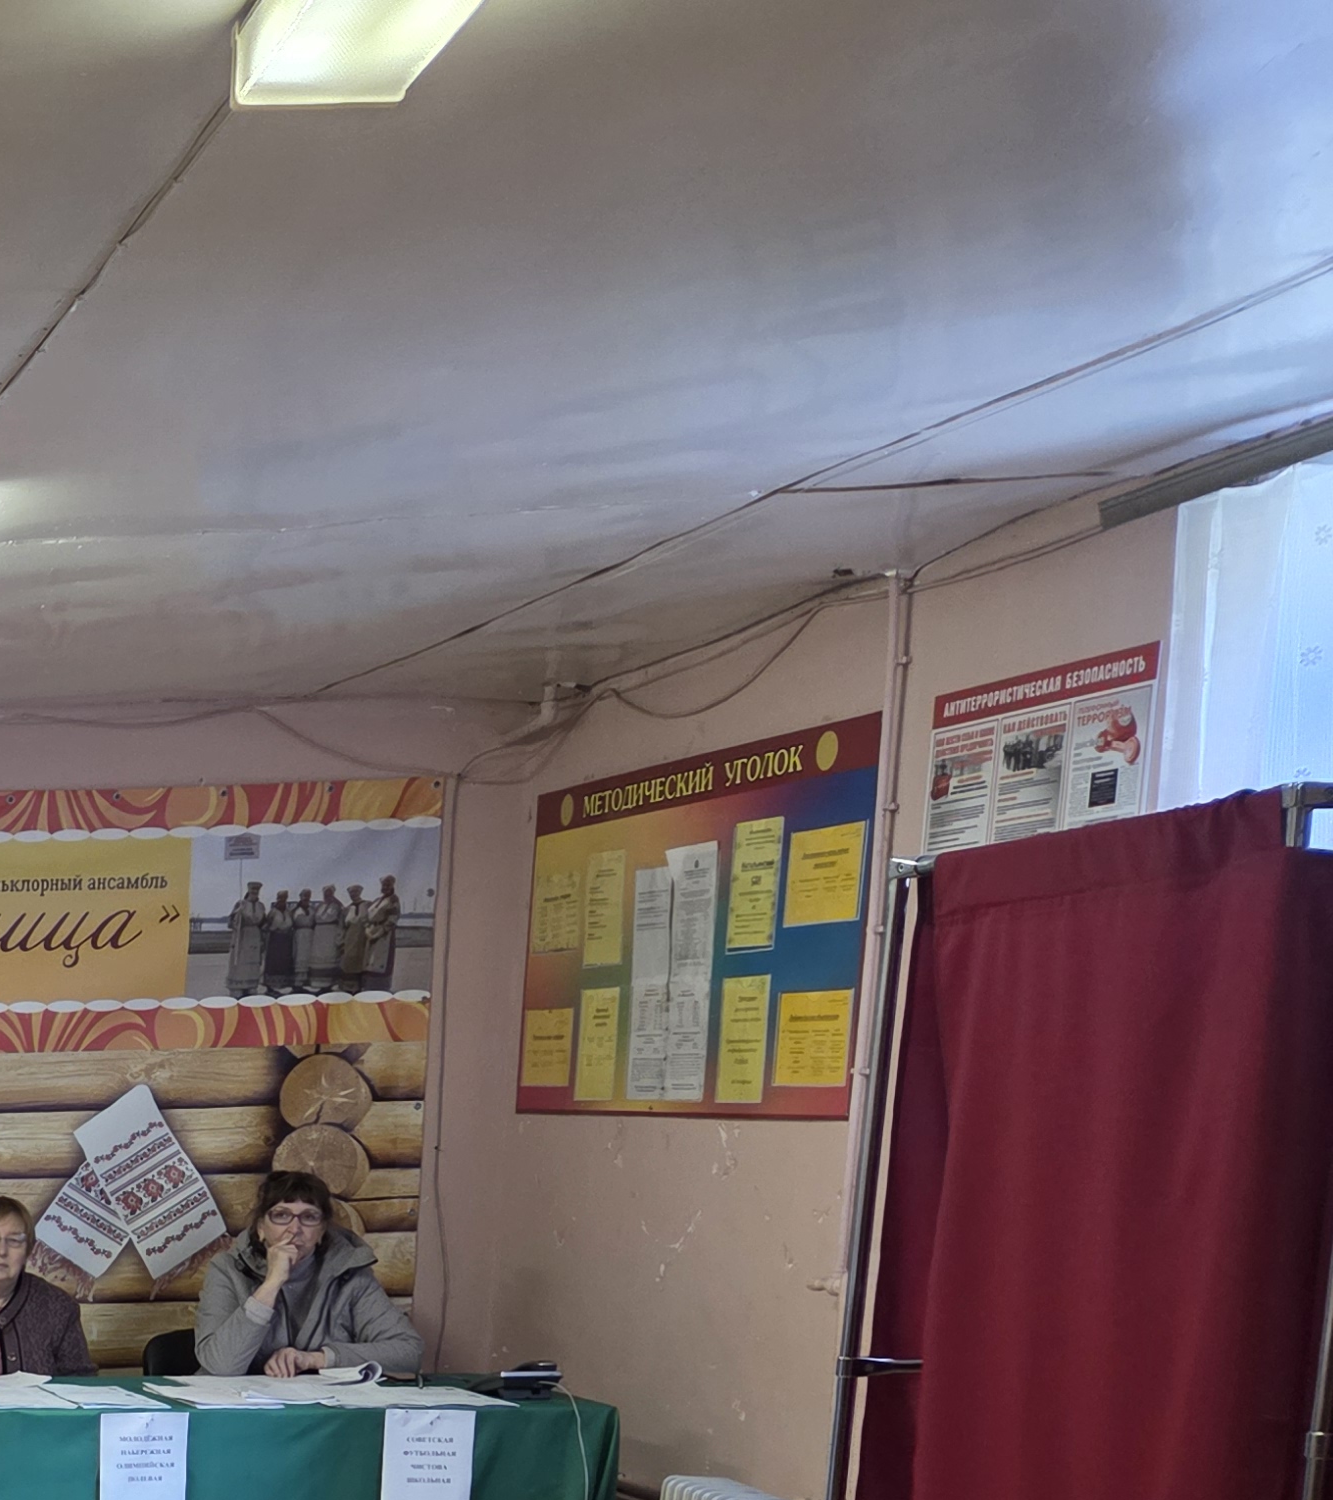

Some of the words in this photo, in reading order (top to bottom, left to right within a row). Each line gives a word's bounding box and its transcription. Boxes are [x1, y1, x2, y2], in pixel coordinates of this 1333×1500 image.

[943, 675, 1062, 718] АНТИТЕРРОРИСТИЧЕСКАЯ
[1065, 655, 1147, 690] БЕЗОПАСНОСТЬ
[581, 762, 714, 819] МЕТОДИЧЕСКИЙ
[724, 744, 804, 788] УГОЛОК
[87, 872, 169, 892] ансамбль
